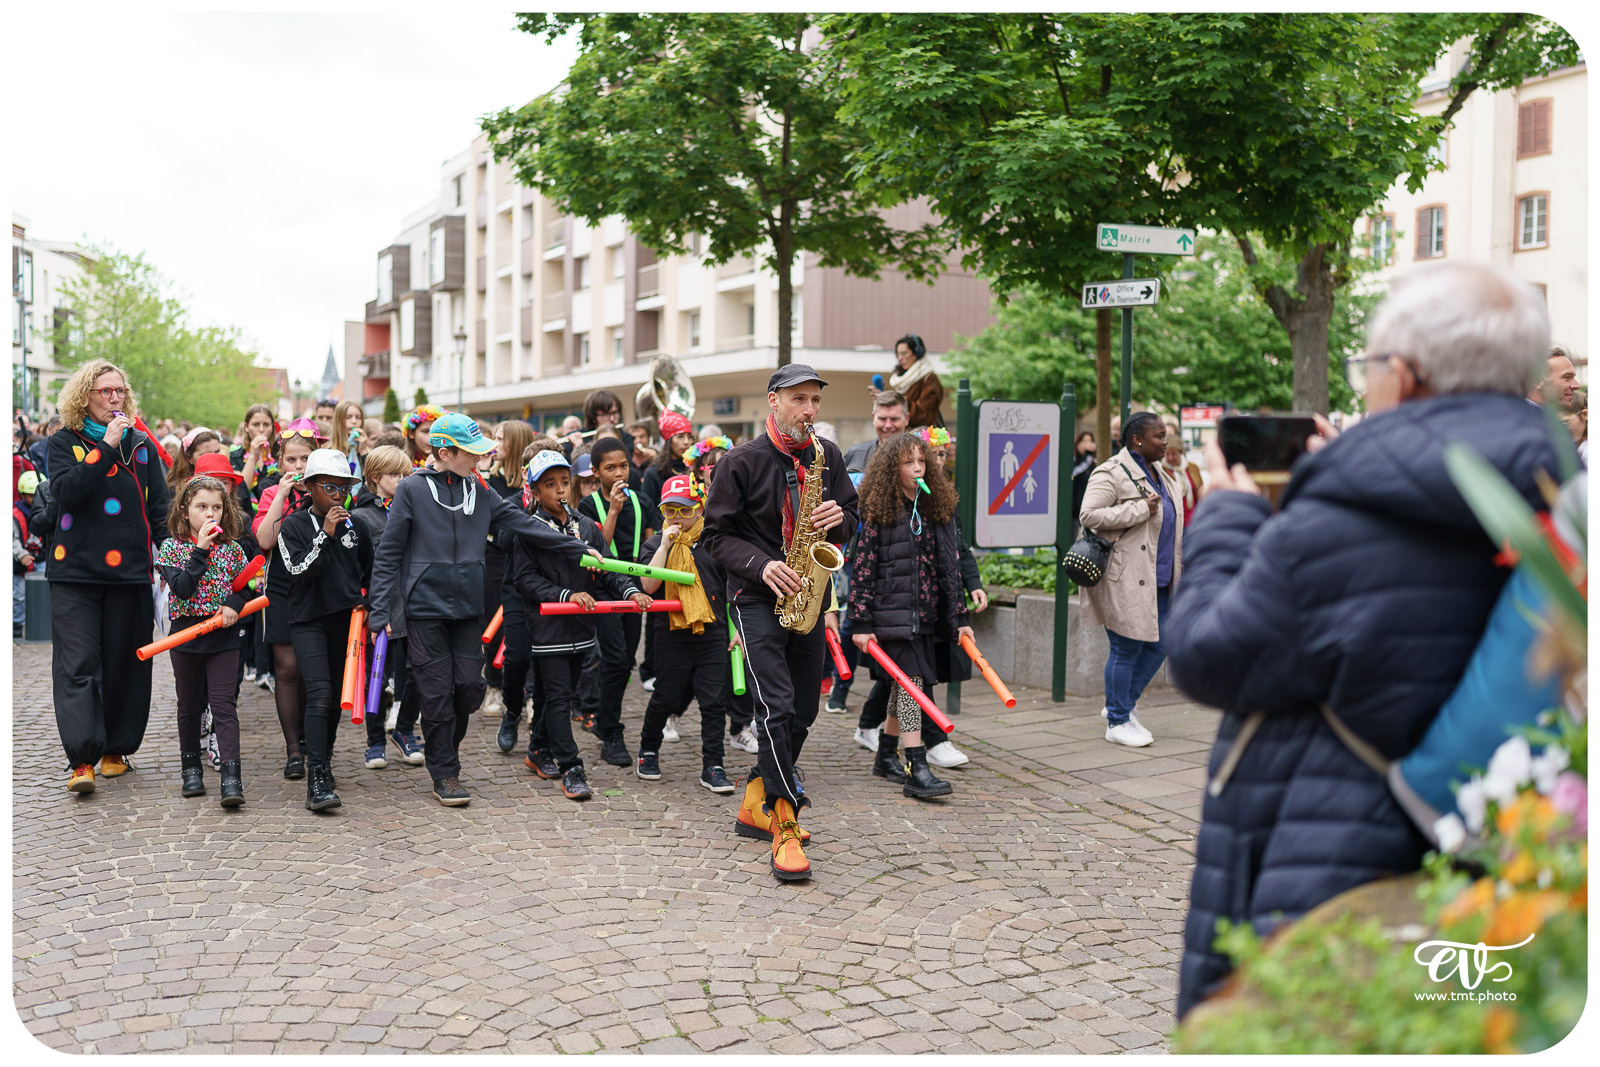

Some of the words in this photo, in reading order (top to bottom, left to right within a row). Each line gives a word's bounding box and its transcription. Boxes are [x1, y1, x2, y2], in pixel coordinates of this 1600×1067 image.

[1120, 233, 1151, 244] Mairie
[1116, 284, 1134, 293] Office
[1116, 295, 1142, 304] Tourisme
[670, 479, 685, 493] C
